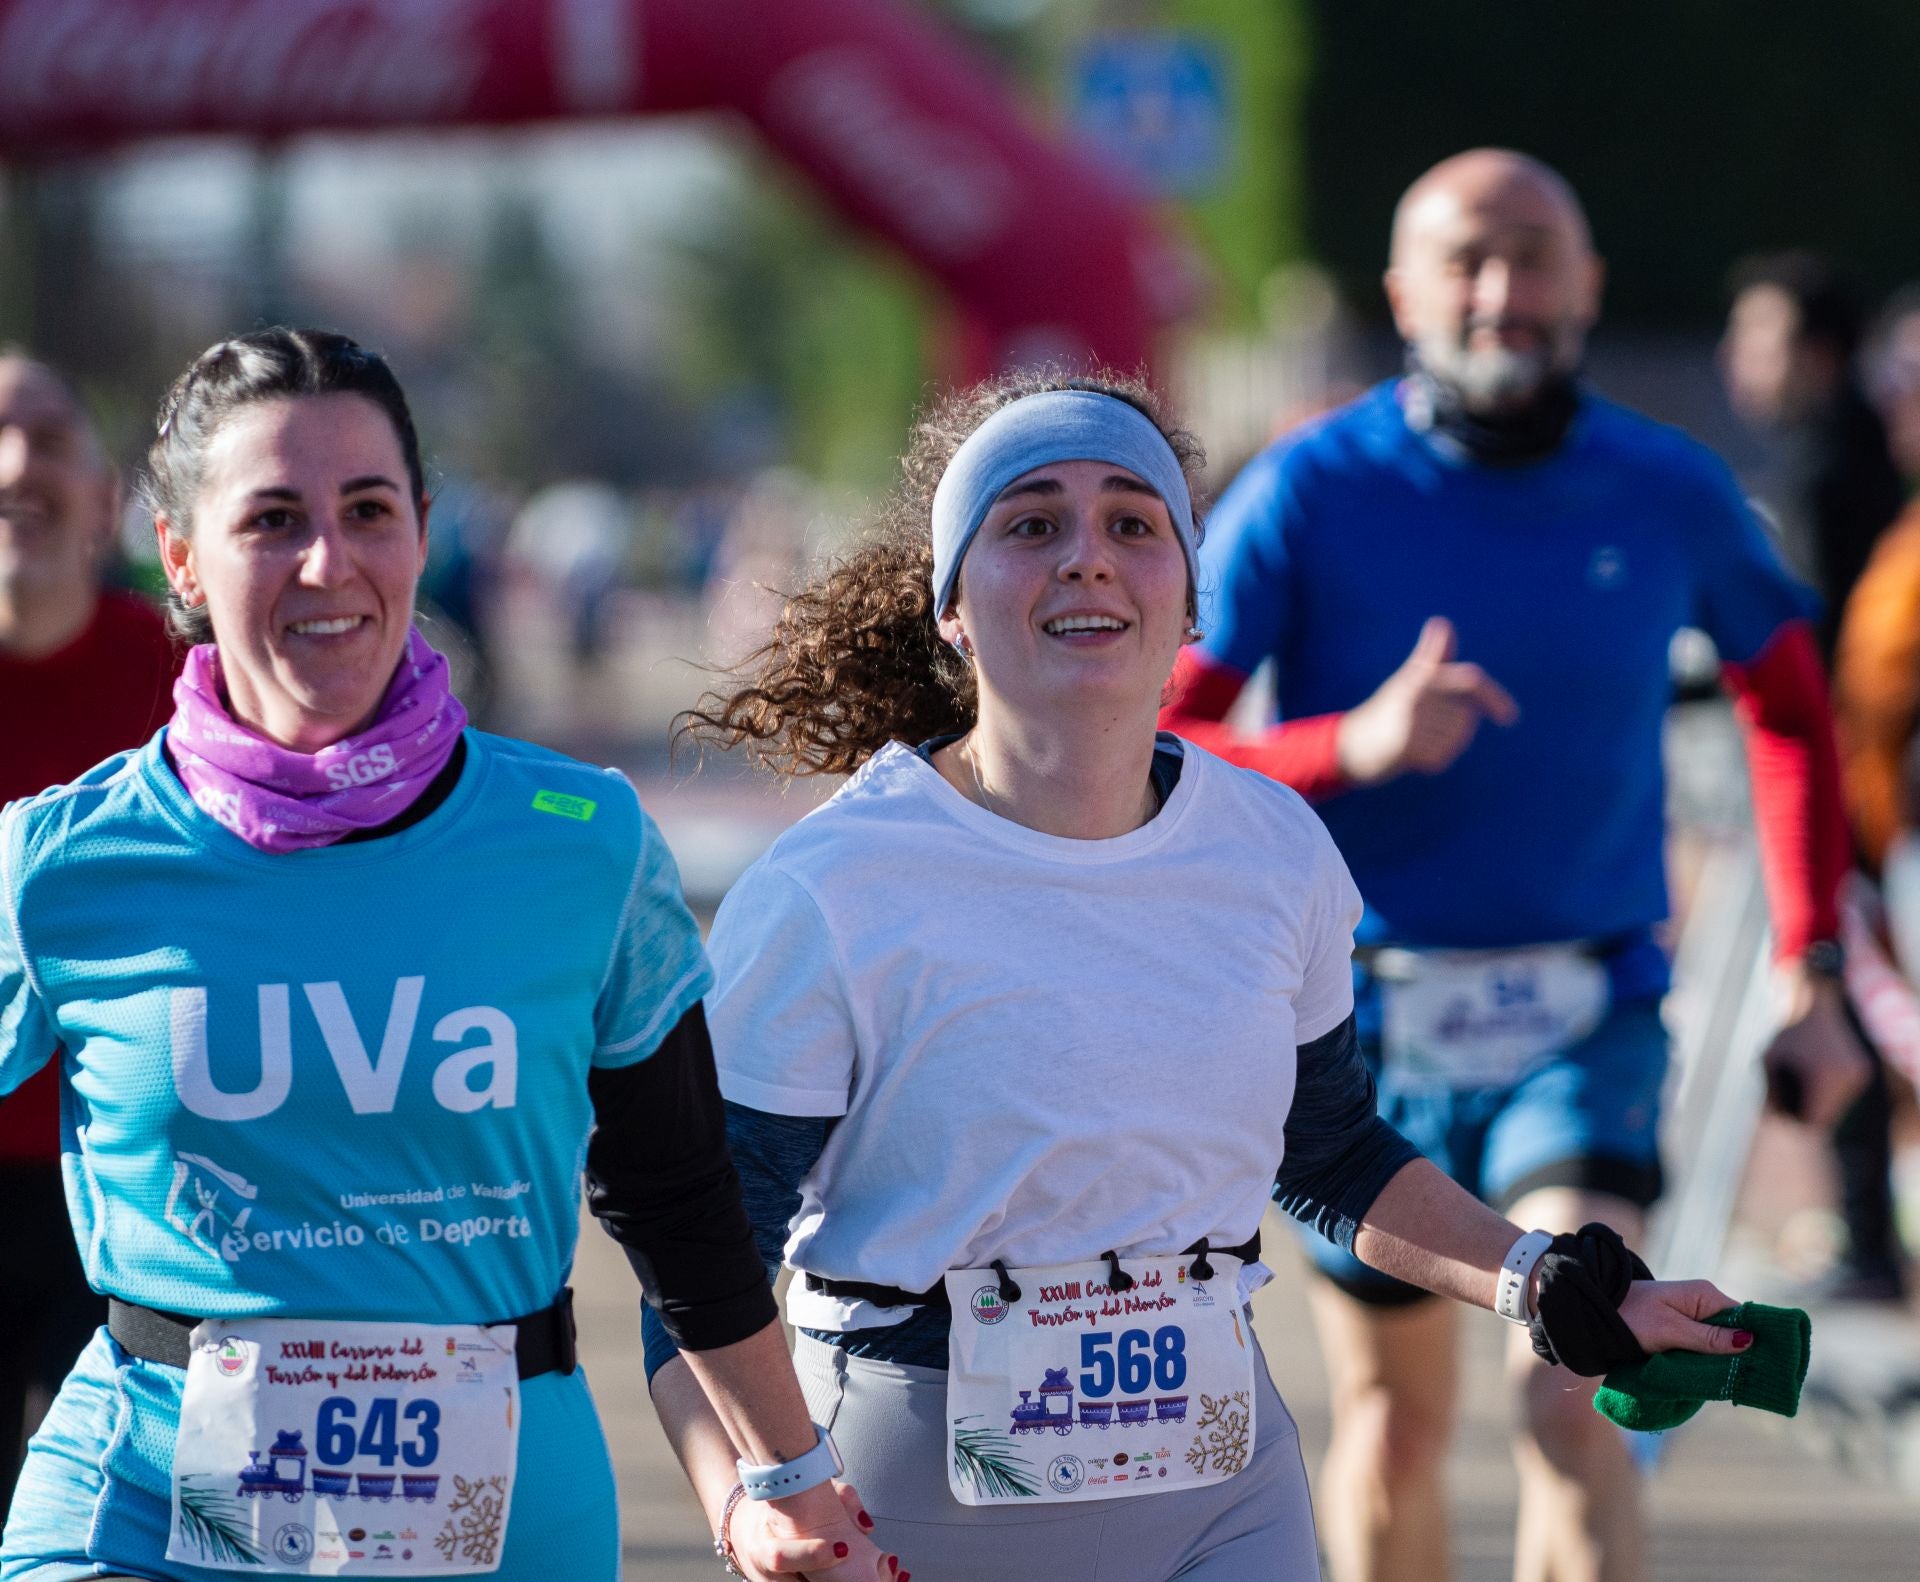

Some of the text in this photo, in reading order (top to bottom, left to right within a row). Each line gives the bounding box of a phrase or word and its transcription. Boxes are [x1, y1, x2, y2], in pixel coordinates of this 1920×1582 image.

[325, 743, 397, 791] SGS
[169, 975, 518, 1122] UVa
[340, 1186, 443, 1209] Universidad
[447, 1183, 466, 1201] de
[376, 1220, 409, 1246] de
[1142, 1269, 1163, 1288] del
[1085, 1308, 1098, 1326] y
[1100, 1299, 1123, 1317] del
[400, 1337, 424, 1356] del
[1080, 1325, 1187, 1398] 568
[326, 1371, 339, 1389] y
[343, 1362, 369, 1382] del
[315, 1395, 441, 1468] 643
